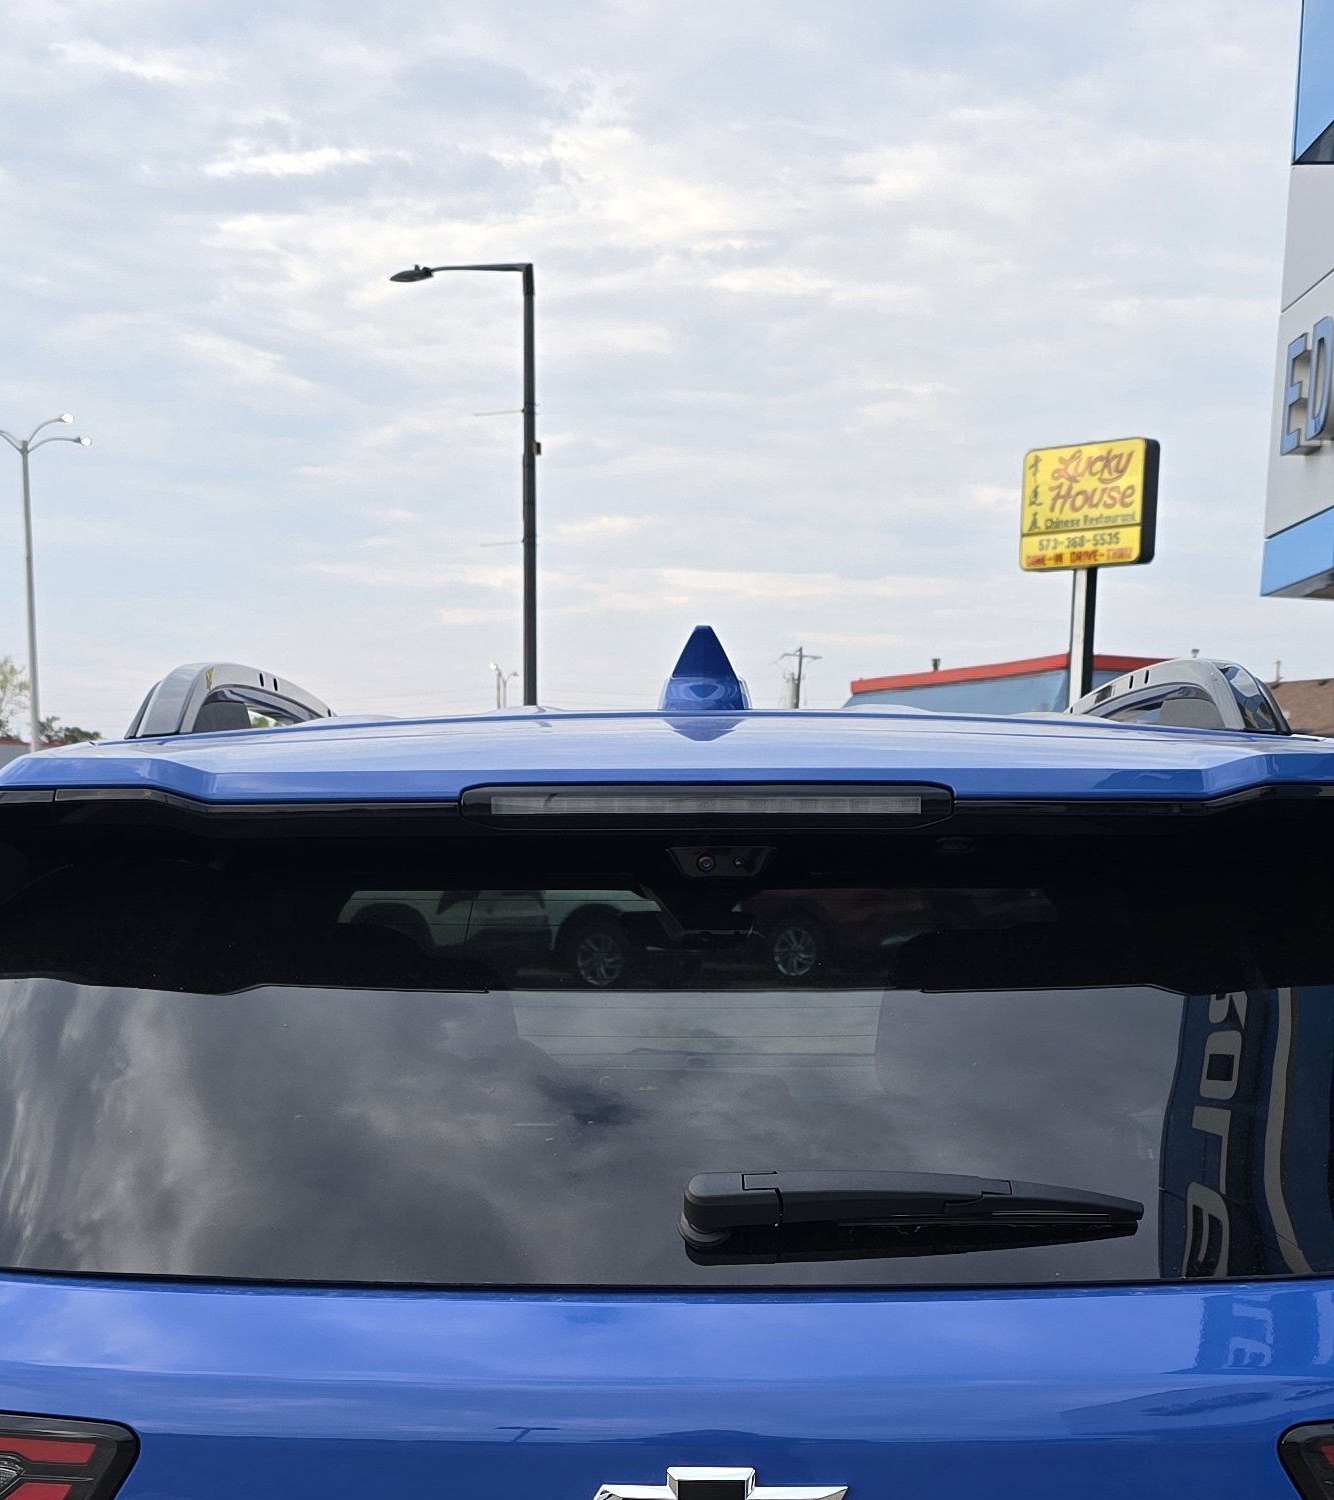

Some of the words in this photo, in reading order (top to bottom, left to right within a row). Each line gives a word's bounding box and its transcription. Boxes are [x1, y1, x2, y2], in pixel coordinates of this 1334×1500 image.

[1280, 315, 1334, 456] ED
[1051, 449, 1134, 485] Lucky
[1049, 484, 1135, 514] House
[1045, 517, 1080, 530] Chinese
[1083, 512, 1136, 525] Restaurant
